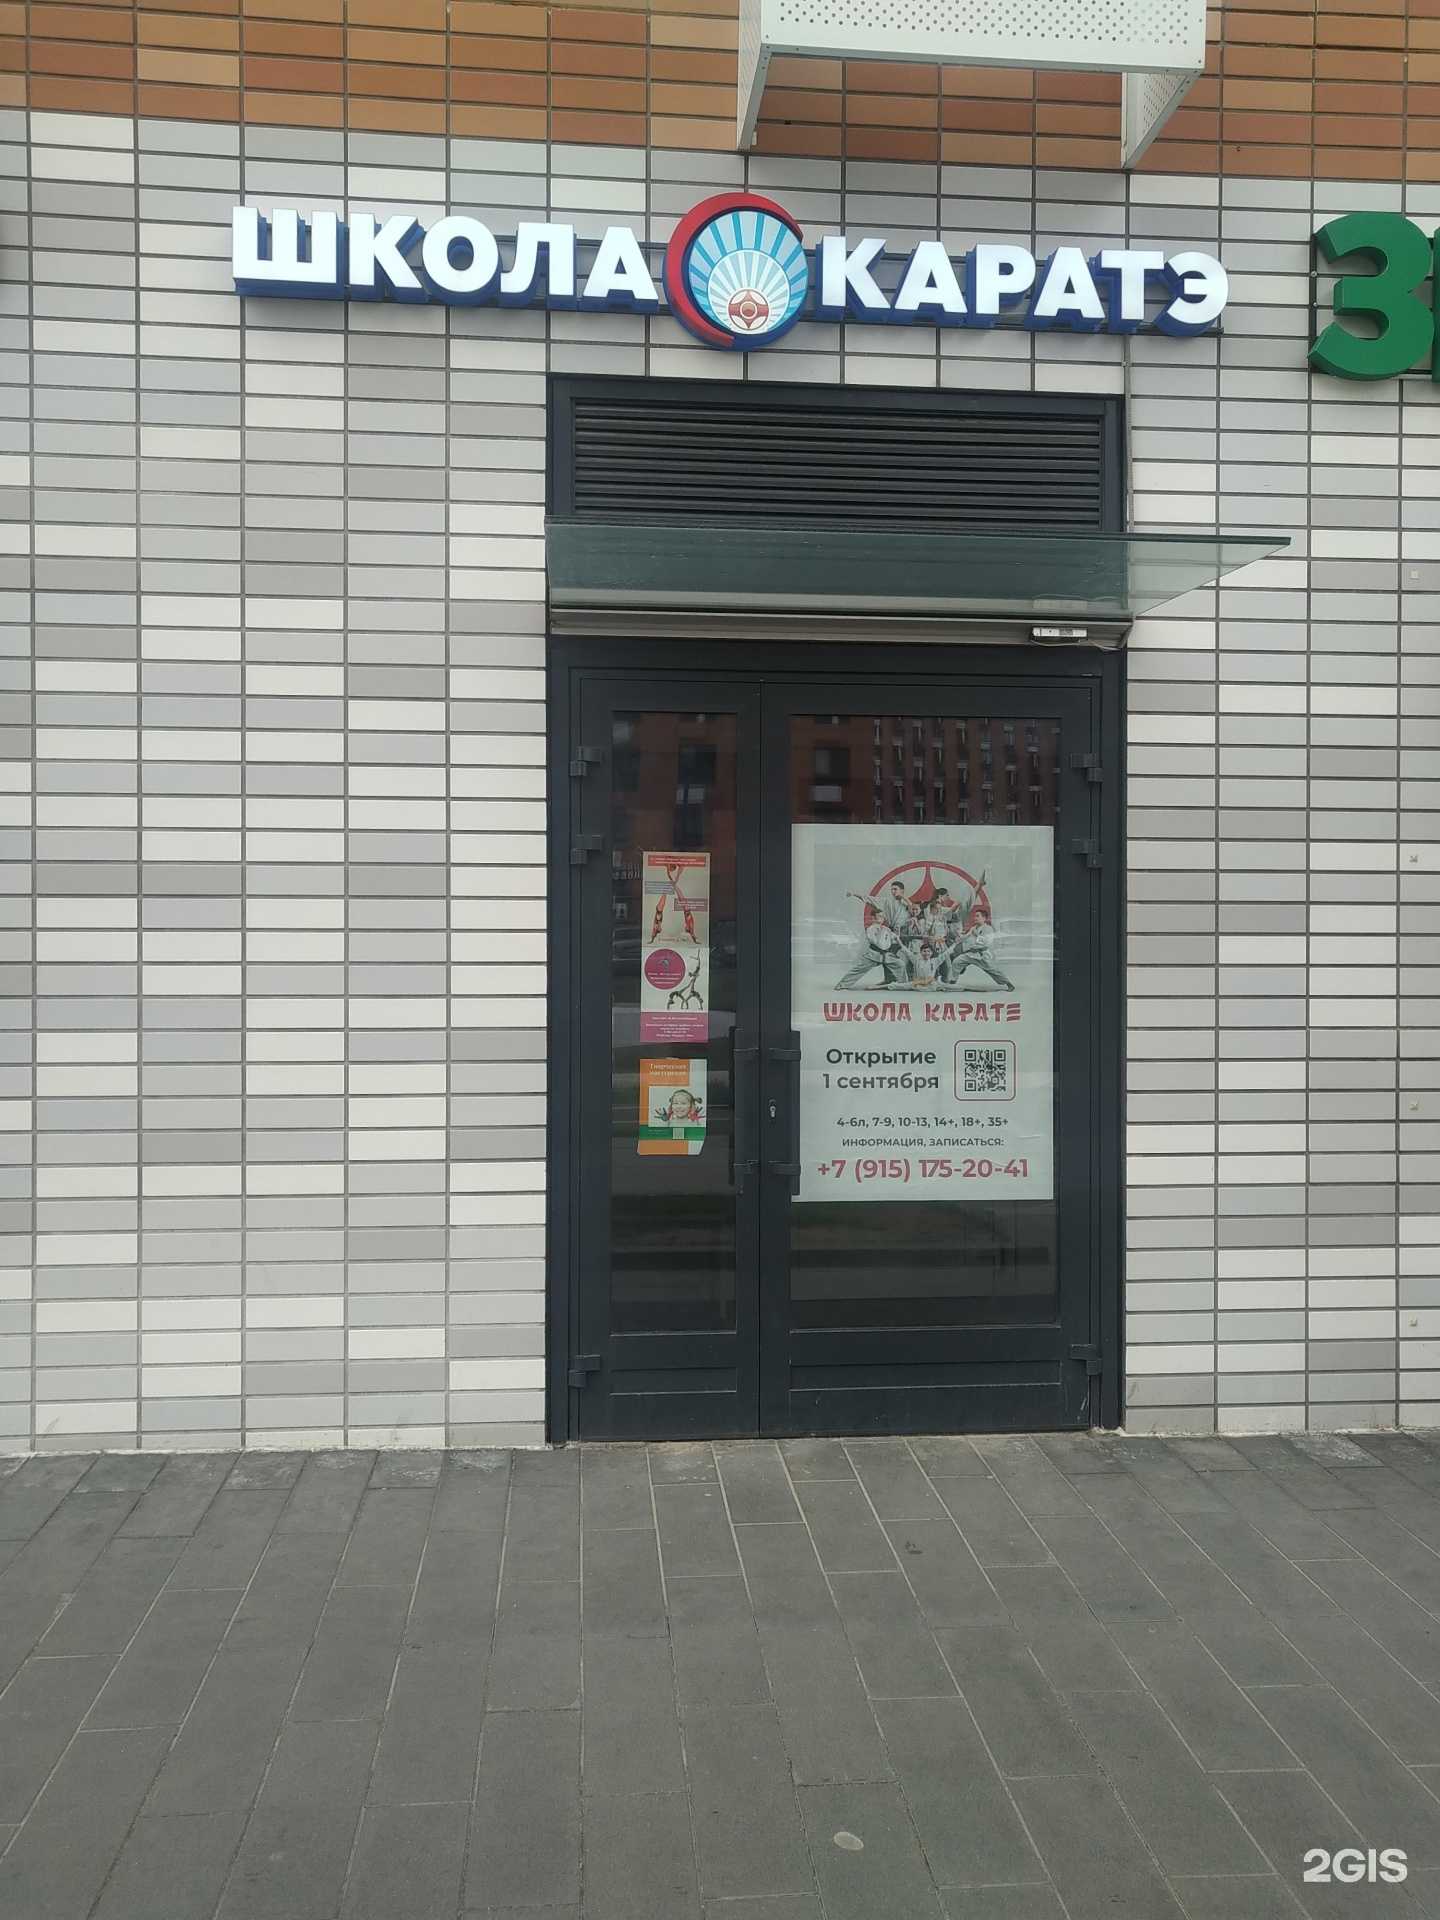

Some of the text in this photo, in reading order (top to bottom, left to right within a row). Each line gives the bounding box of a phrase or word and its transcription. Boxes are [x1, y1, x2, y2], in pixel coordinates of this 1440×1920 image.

[232, 206, 1230, 328] ШКОЛА КАРАТЭ
[823, 1002, 912, 1022] ШКОЛА
[826, 1048, 937, 1068] Открытие
[823, 1072, 939, 1092] 1 сентября
[837, 1116, 1009, 1128] 4-6л, 7-9, 10-13, 14+, 18+, 35+
[842, 1138, 1004, 1147] ИНФОРМАЦИЯ, ЗАПИСАТЬСЯ:
[818, 1159, 1028, 1182] +7 (915) 175-20-41
